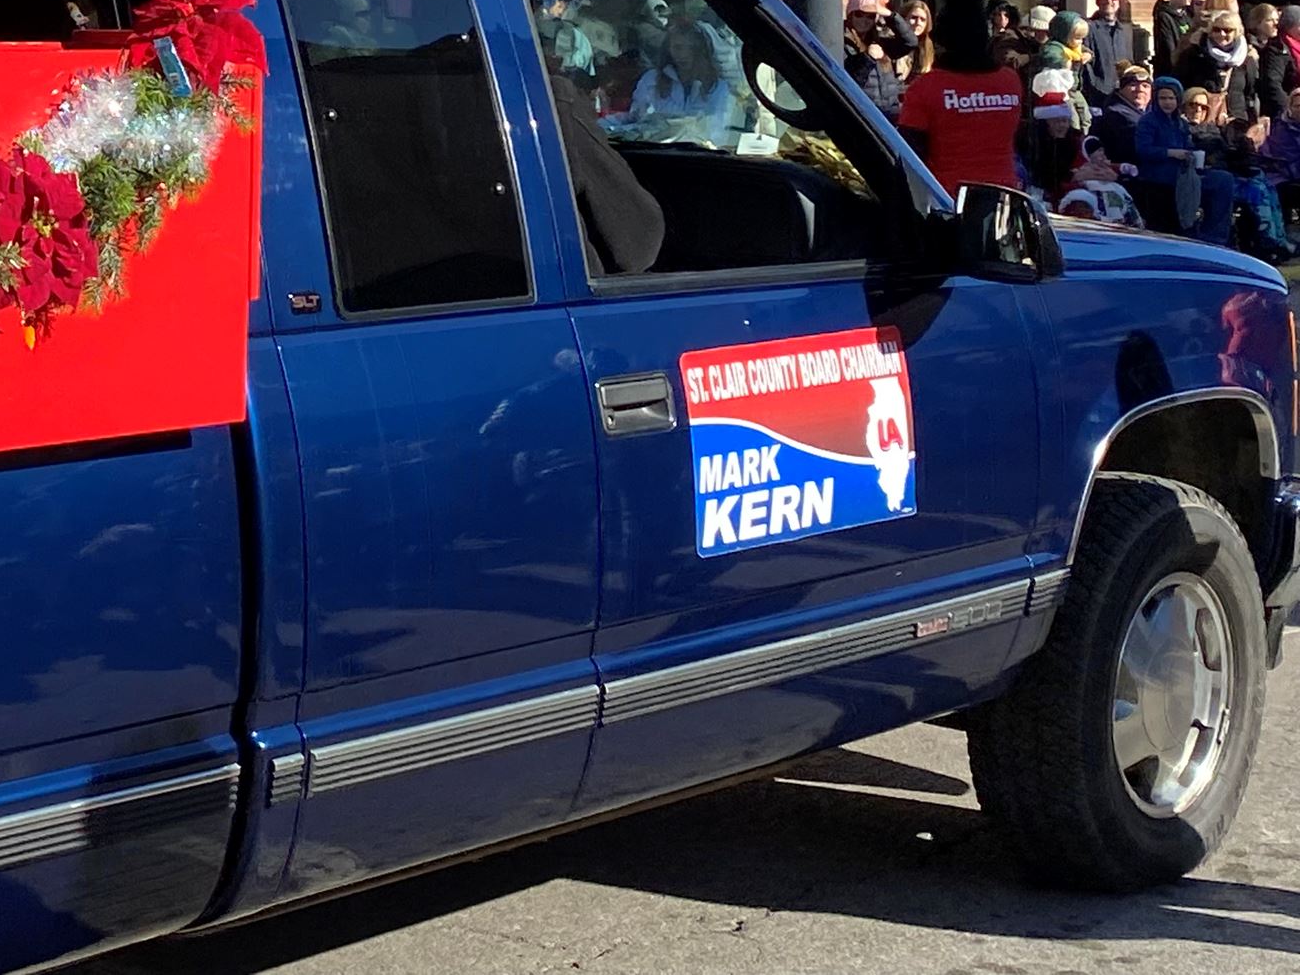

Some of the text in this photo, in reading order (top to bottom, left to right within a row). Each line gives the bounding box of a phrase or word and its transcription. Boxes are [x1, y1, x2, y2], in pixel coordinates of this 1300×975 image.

[944, 91, 1019, 110] Hoffman
[292, 294, 320, 309] SLT
[686, 367, 709, 404] ST.
[710, 361, 749, 401] CLAIR
[749, 353, 800, 396] COUNTY
[798, 348, 842, 386] BOARD
[699, 443, 781, 495] MARK
[701, 477, 834, 549] KERN
